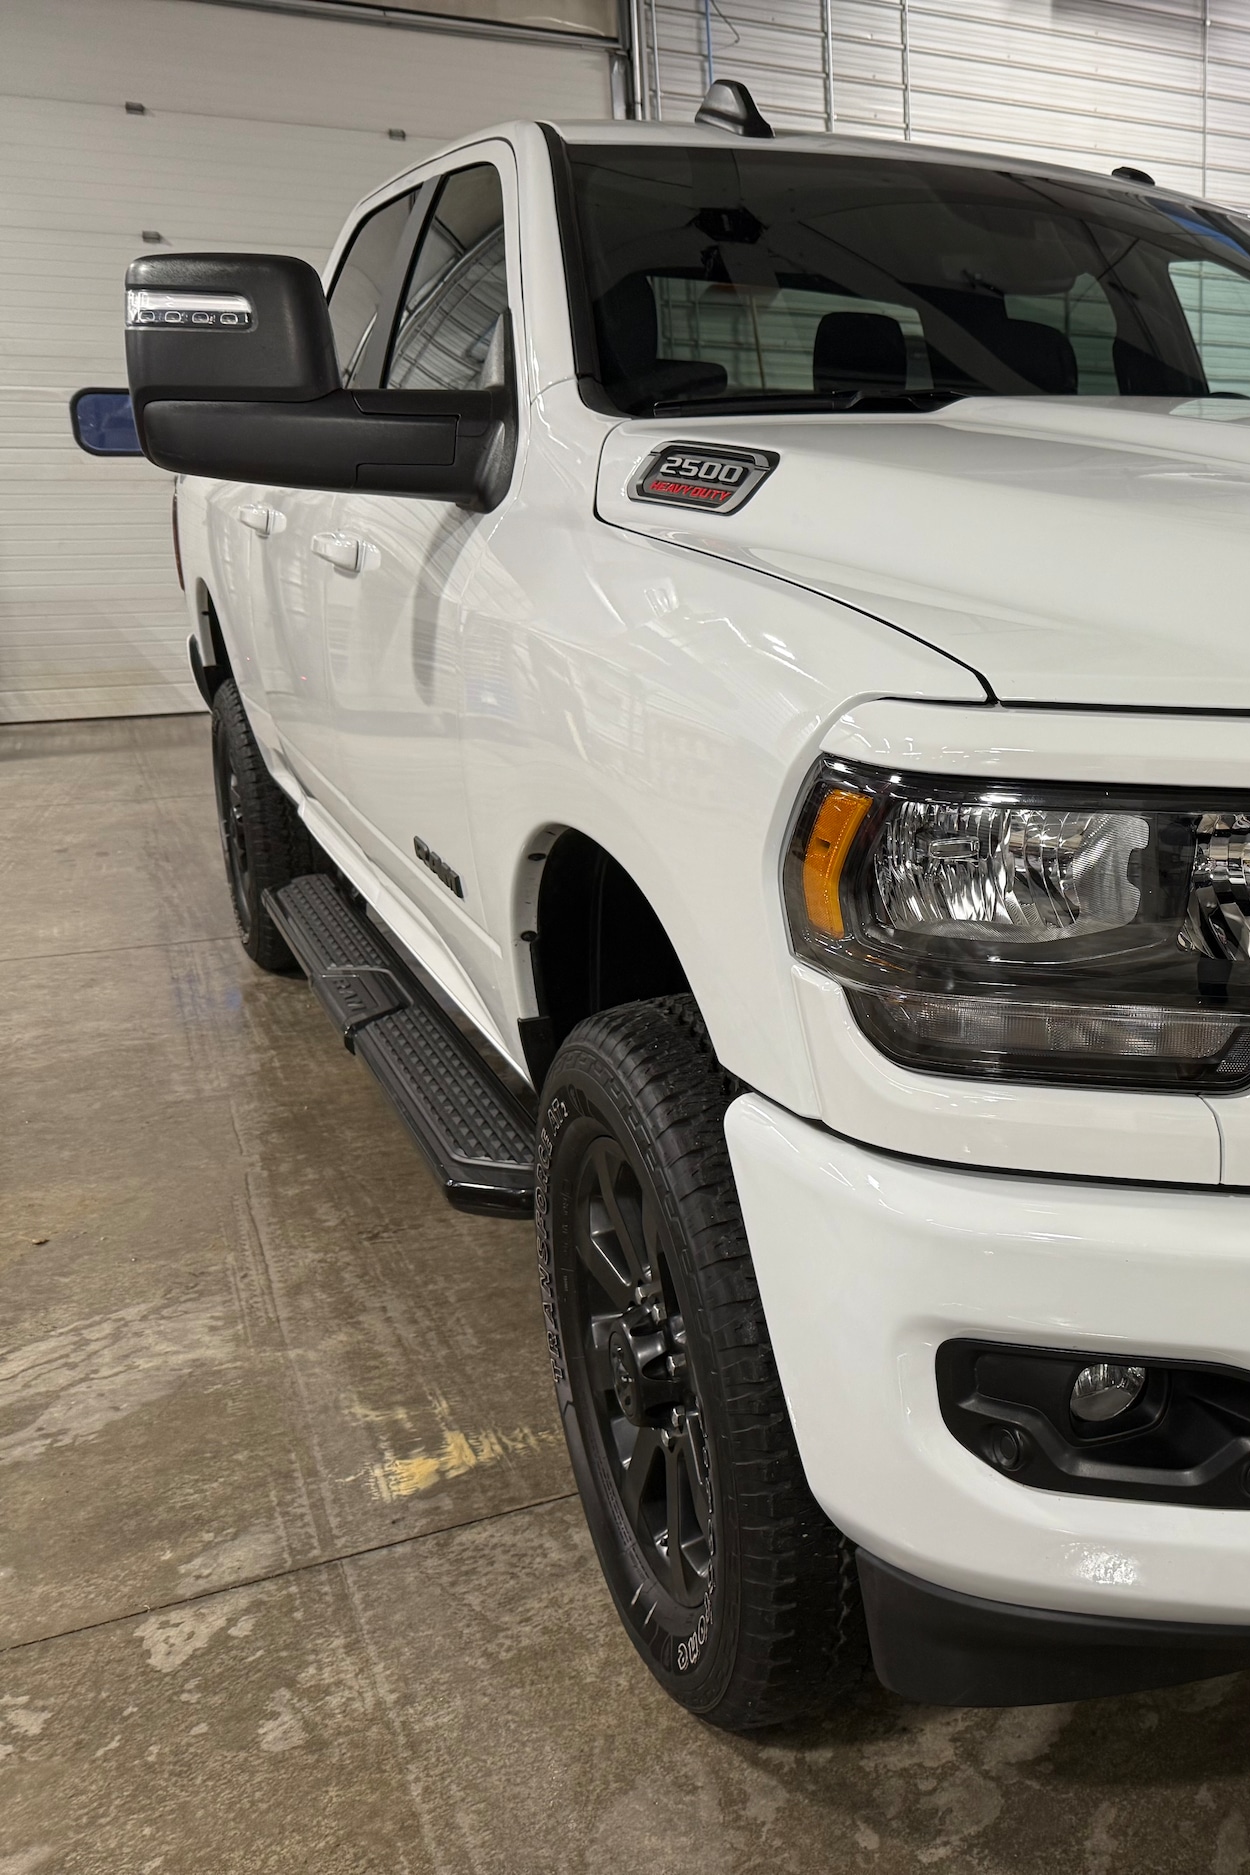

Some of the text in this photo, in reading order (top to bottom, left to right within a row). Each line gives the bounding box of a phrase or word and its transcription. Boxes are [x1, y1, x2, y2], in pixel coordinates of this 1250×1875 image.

[659, 456, 745, 484] 2500
[649, 481, 731, 501] HEAVY DUTY
[331, 976, 367, 1012] RAM
[534, 1127, 565, 1383] TRANSFORCE
